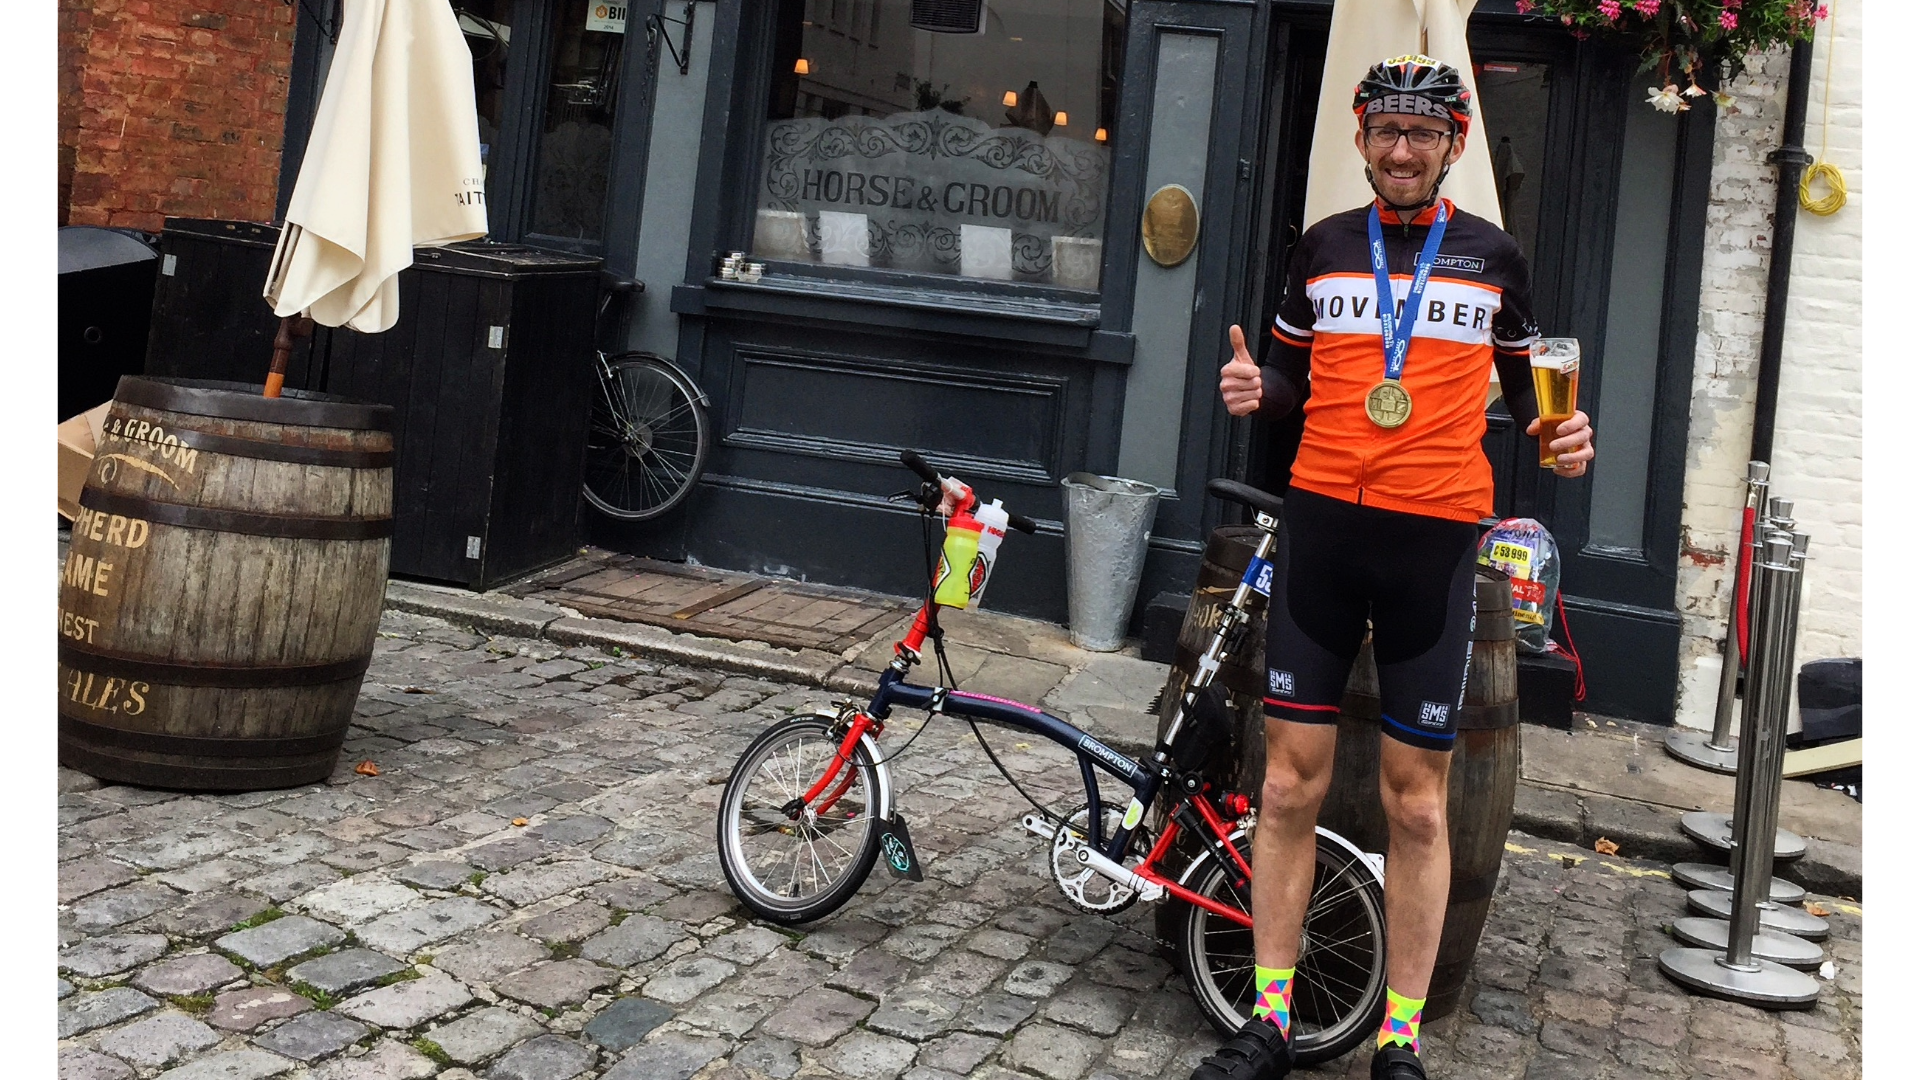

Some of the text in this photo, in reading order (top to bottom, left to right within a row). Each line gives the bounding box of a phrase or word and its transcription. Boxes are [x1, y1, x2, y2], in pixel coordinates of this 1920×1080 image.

[1366, 93, 1452, 120] BEERS
[463, 177, 484, 187] CH
[801, 168, 1063, 224] HORSE & GROOM
[1433, 256, 1480, 270] OMPTON
[123, 418, 199, 475] GROOM
[64, 668, 150, 716] ALES
[1082, 738, 1133, 772] BROMPTON
